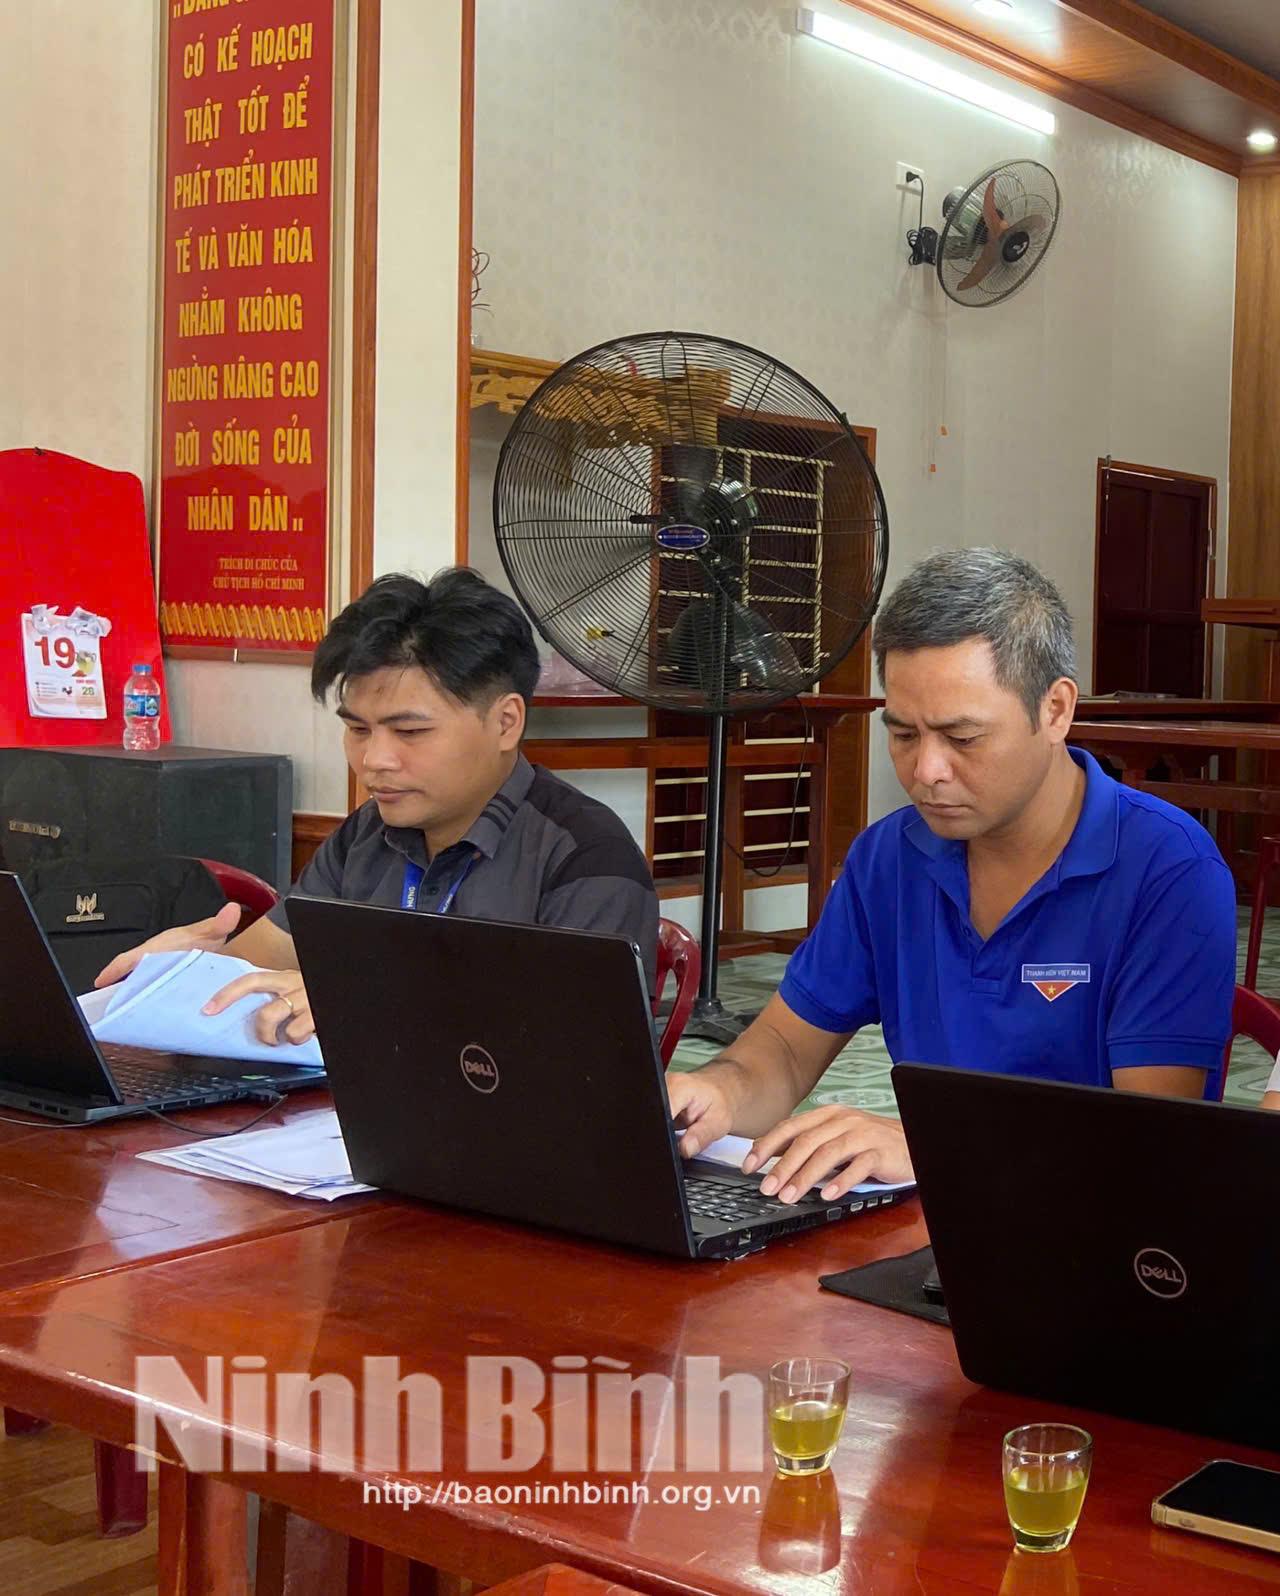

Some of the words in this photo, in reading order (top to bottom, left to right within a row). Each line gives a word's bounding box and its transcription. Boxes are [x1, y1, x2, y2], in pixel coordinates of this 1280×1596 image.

[184, 33, 204, 79] CÓ
[217, 24, 241, 72] KẾ
[251, 23, 313, 70] HOẠCH
[184, 98, 222, 147] THẬT
[238, 85, 269, 134] TỐT
[283, 75, 310, 129] ĐỂ
[174, 164, 211, 210] PHÁT
[215, 149, 265, 203] TRIỂN
[270, 157, 318, 197] KINH
[176, 227, 192, 273] TẾ
[199, 227, 219, 271] VÀ
[227, 223, 263, 268] VĂN
[273, 219, 313, 264] HÓA
[179, 286, 225, 337] NHẰM
[238, 287, 303, 332] KHÔNG
[167, 355, 218, 402] NGỪNG
[223, 355, 274, 399] NÂNG
[280, 360, 319, 398] CAO
[175, 422, 200, 466] ĐỜI
[212, 418, 259, 465] SỐNG
[274, 414, 312, 464] CỦA
[188, 488, 233, 531] NHÂN
[281, 578, 304, 590] MINH
[34, 636, 75, 668] 19
[463, 1060, 495, 1077] DELL
[1141, 1263, 1182, 1283] DELL
